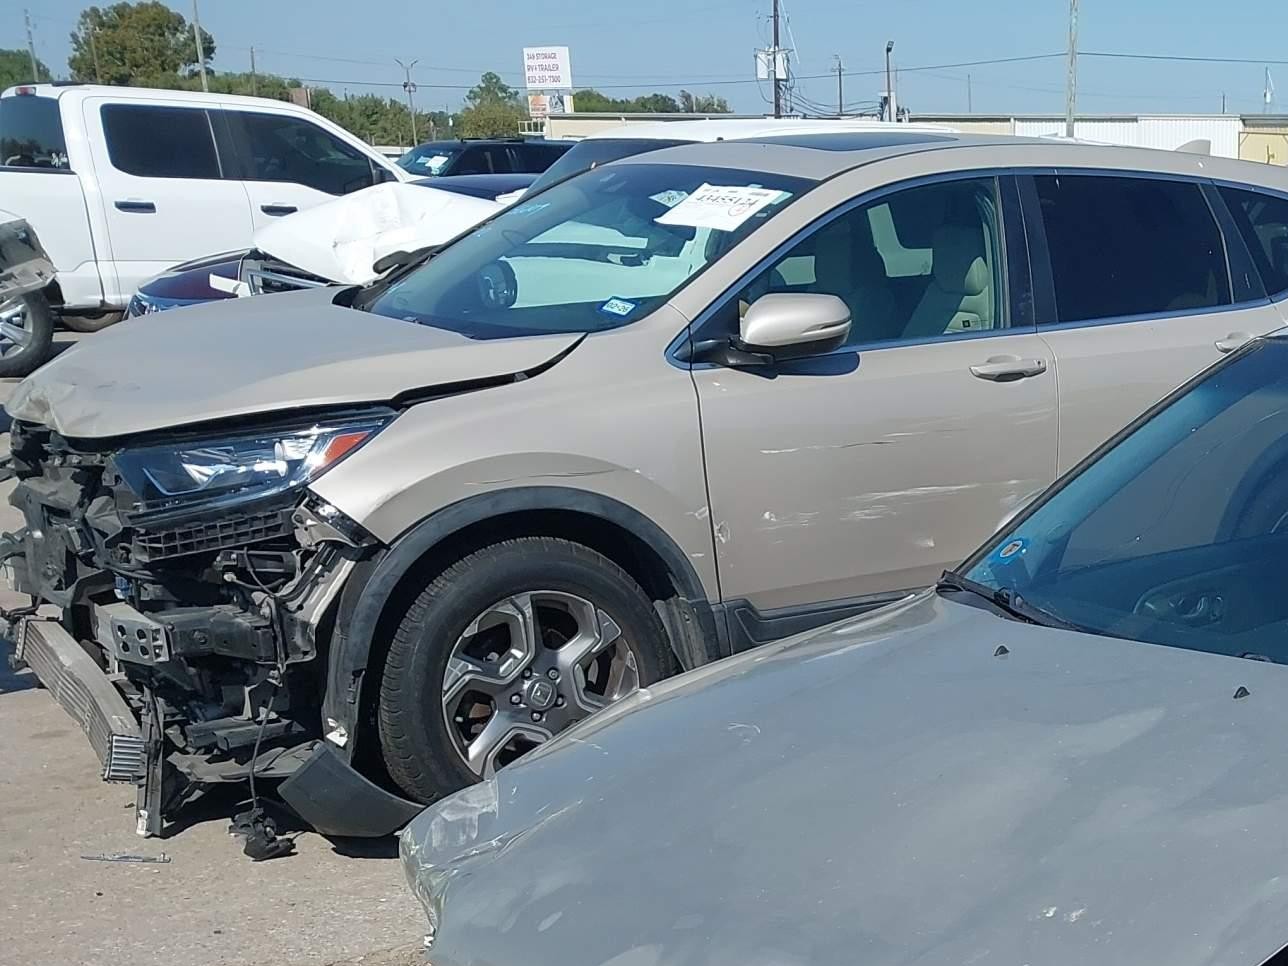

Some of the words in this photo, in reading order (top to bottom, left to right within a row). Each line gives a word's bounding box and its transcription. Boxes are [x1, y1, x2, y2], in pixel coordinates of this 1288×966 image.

[535, 52, 557, 60] STORAGE
[526, 64, 534, 73] RV
[538, 63, 559, 72] TRAILER
